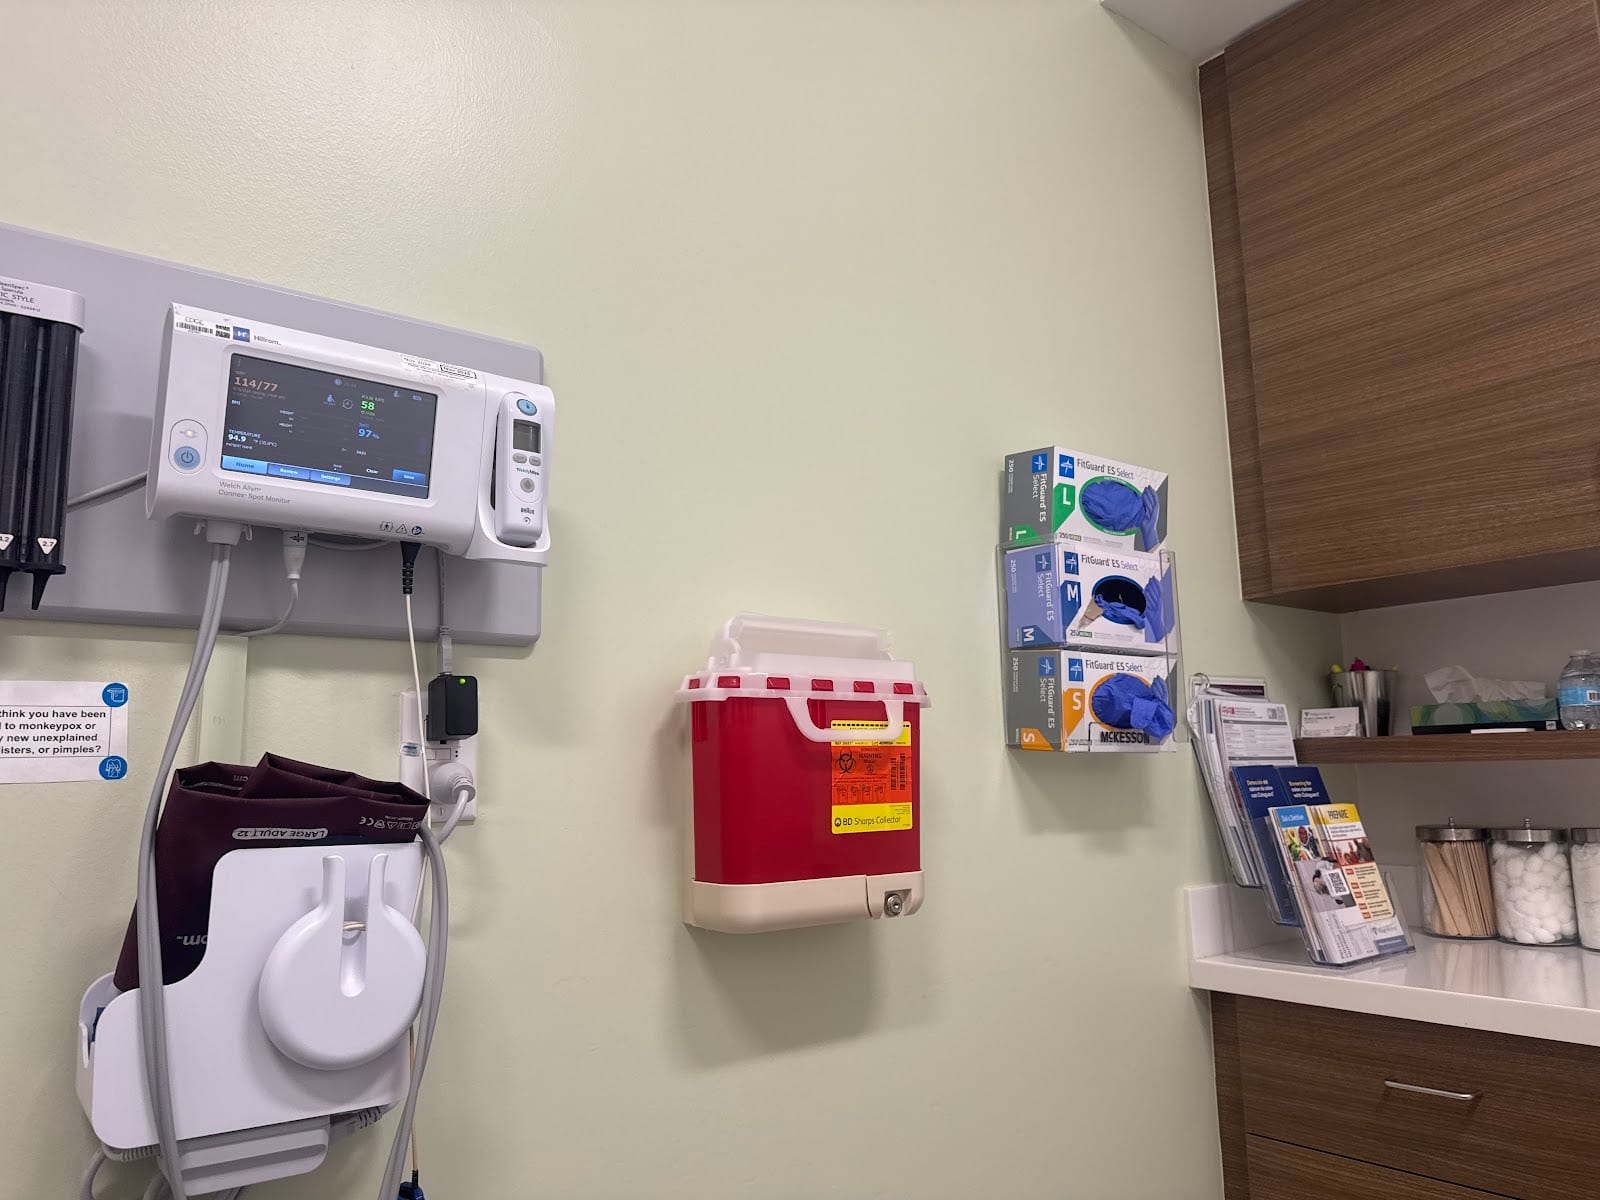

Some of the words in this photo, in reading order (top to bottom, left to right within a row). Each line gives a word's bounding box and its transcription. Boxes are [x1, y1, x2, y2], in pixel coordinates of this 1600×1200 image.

[12, 294, 35, 303] STYLE
[234, 376, 278, 392] 114/77
[361, 400, 375, 410] 58
[228, 433, 247, 442] 94.9
[358, 428, 372, 438] 97
[1077, 459, 1105, 473] FitGuard
[1107, 466, 1116, 475] ES
[1116, 468, 1134, 480] Select
[219, 481, 241, 490] Welch
[1039, 473, 1047, 508] FitGuard
[248, 493, 264, 501] Spot
[266, 495, 291, 504] Monitor
[1062, 488, 1071, 506] L
[1040, 511, 1047, 522] ES
[1016, 530, 1026, 539] L
[1081, 554, 1109, 566] FitGuard
[1112, 558, 1120, 567] ES
[1121, 560, 1138, 571] Select
[1067, 584, 1079, 601] M
[1047, 610, 1054, 621] ES
[1023, 628, 1034, 642] M
[1086, 660, 1114, 671] FitGuard
[1116, 662, 1125, 671] ES
[1125, 663, 1143, 672] Select
[1072, 692, 1082, 710] S
[28, 711, 49, 719] you
[19, 722, 82, 731] monkeypox
[1048, 717, 1055, 729] ES
[33, 734, 97, 743] unexplained
[1023, 733, 1035, 743] S
[52, 745, 101, 755] pimples?
[855, 817, 874, 827] Sharps
[876, 816, 901, 824] Collector
[237, 829, 249, 837] 12
[251, 829, 286, 838] ADULT
[288, 830, 325, 838] LARGE
